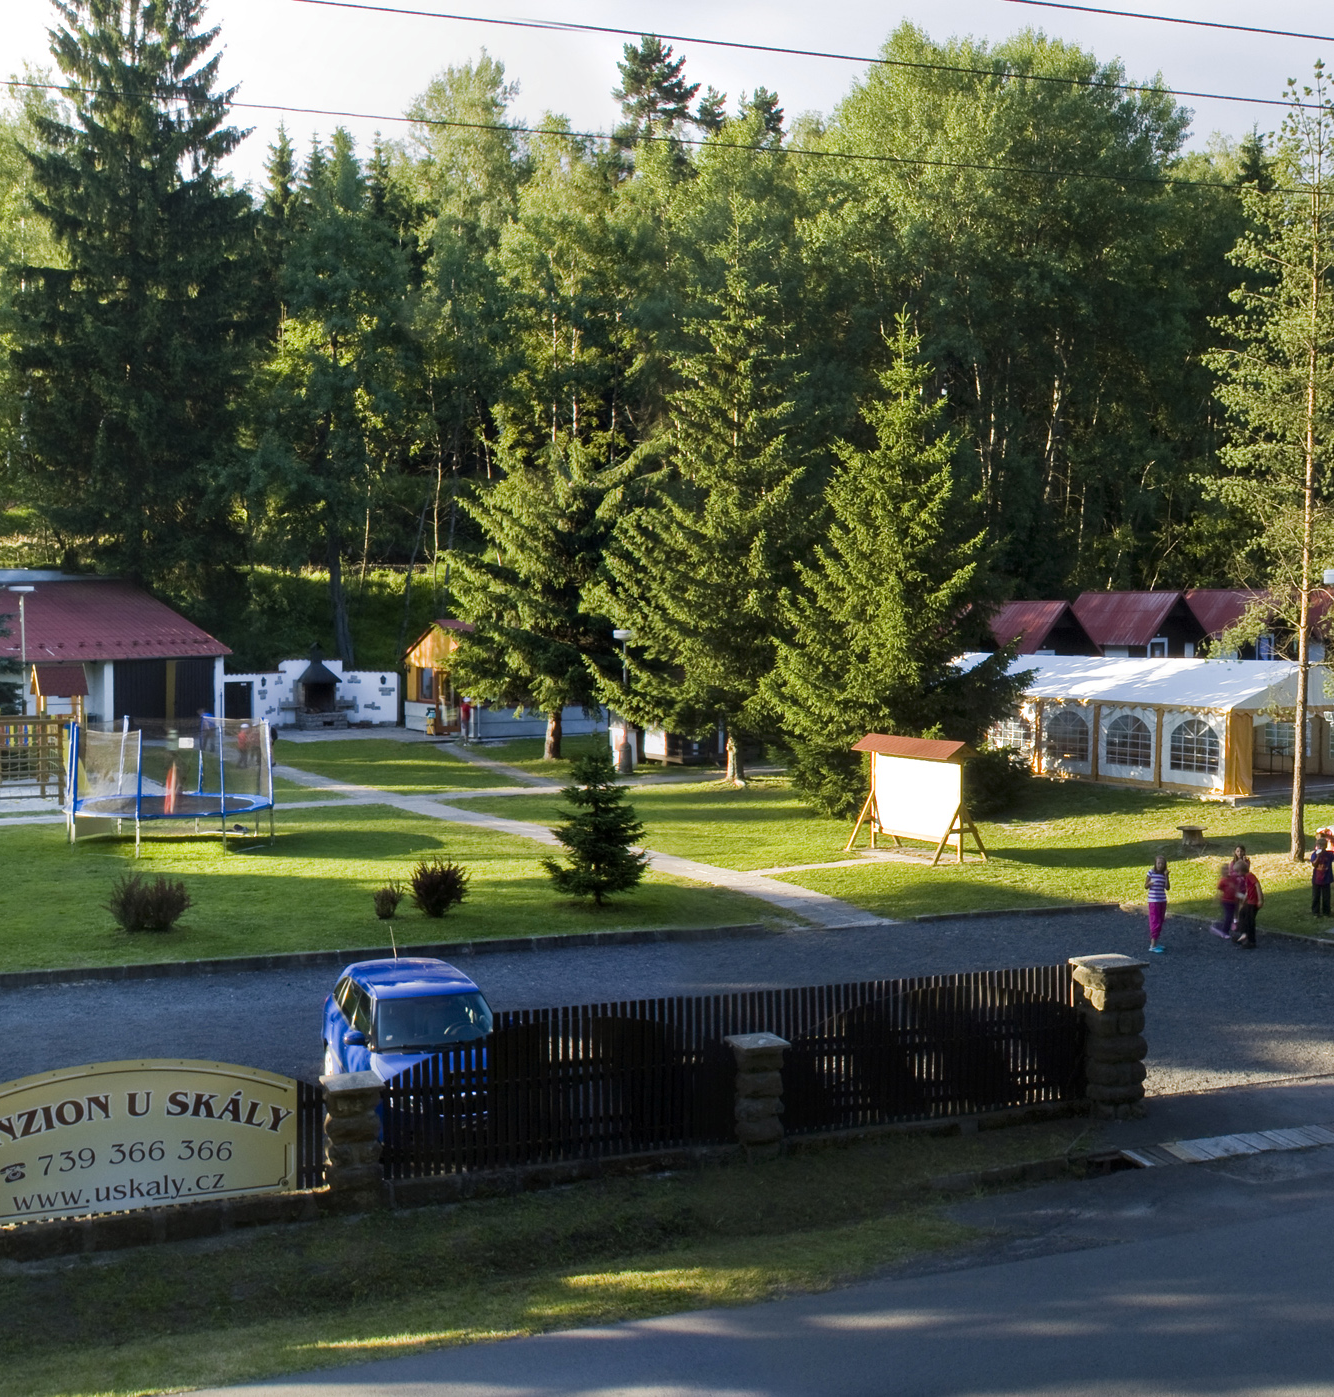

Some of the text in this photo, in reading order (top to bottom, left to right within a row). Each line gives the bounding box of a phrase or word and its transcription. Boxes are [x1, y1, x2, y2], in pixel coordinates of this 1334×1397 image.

[126, 1091, 153, 1117] U
[166, 1090, 294, 1133] SKÁLY
[37, 1139, 233, 1176] 739 366 366
[12, 1173, 225, 1211] www.uskaly.cz
